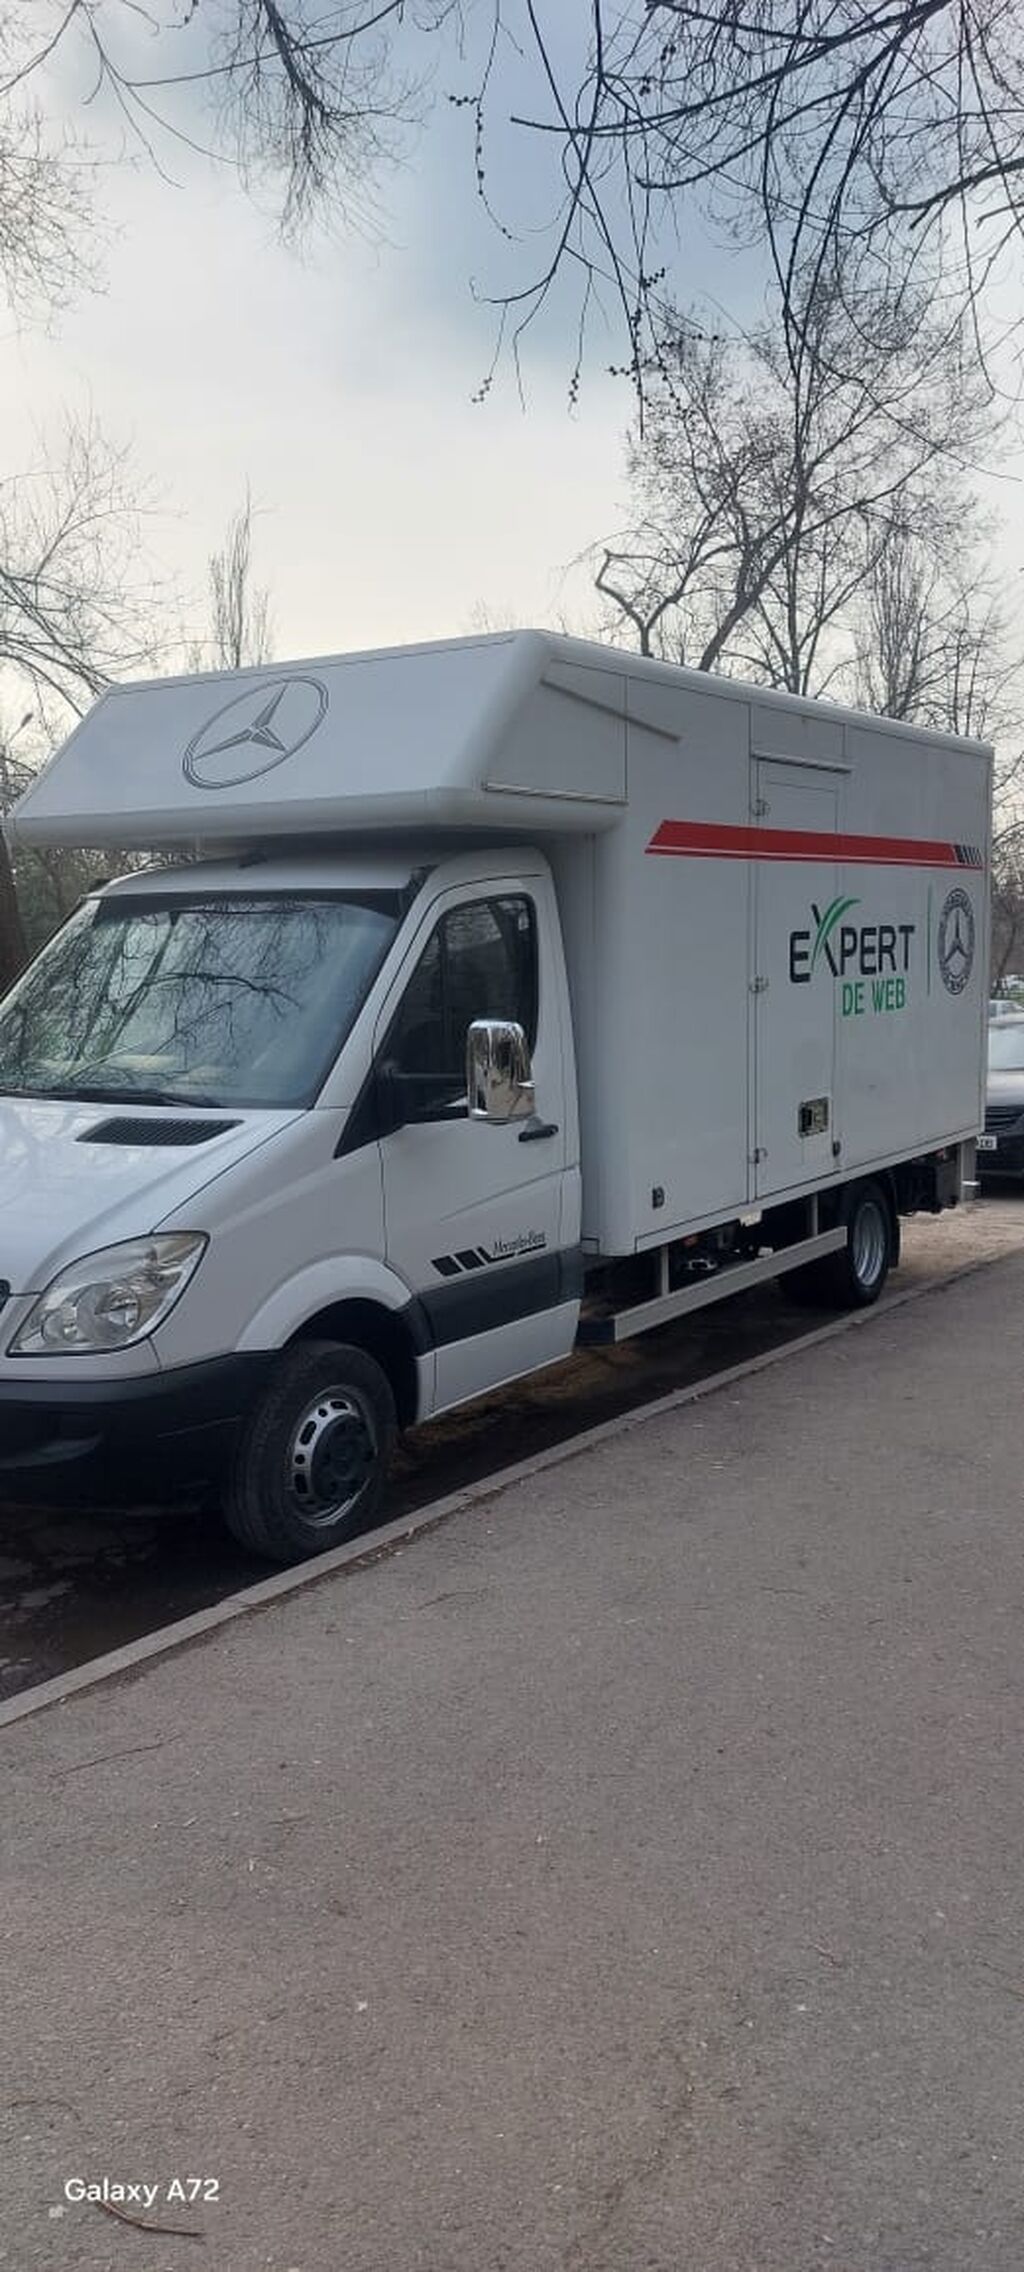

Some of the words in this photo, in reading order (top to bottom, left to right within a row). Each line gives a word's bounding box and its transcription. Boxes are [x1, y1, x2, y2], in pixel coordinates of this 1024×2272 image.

[789, 896, 915, 983] EXPERT
[842, 983, 865, 1016] DE
[872, 979, 905, 1014] WEB
